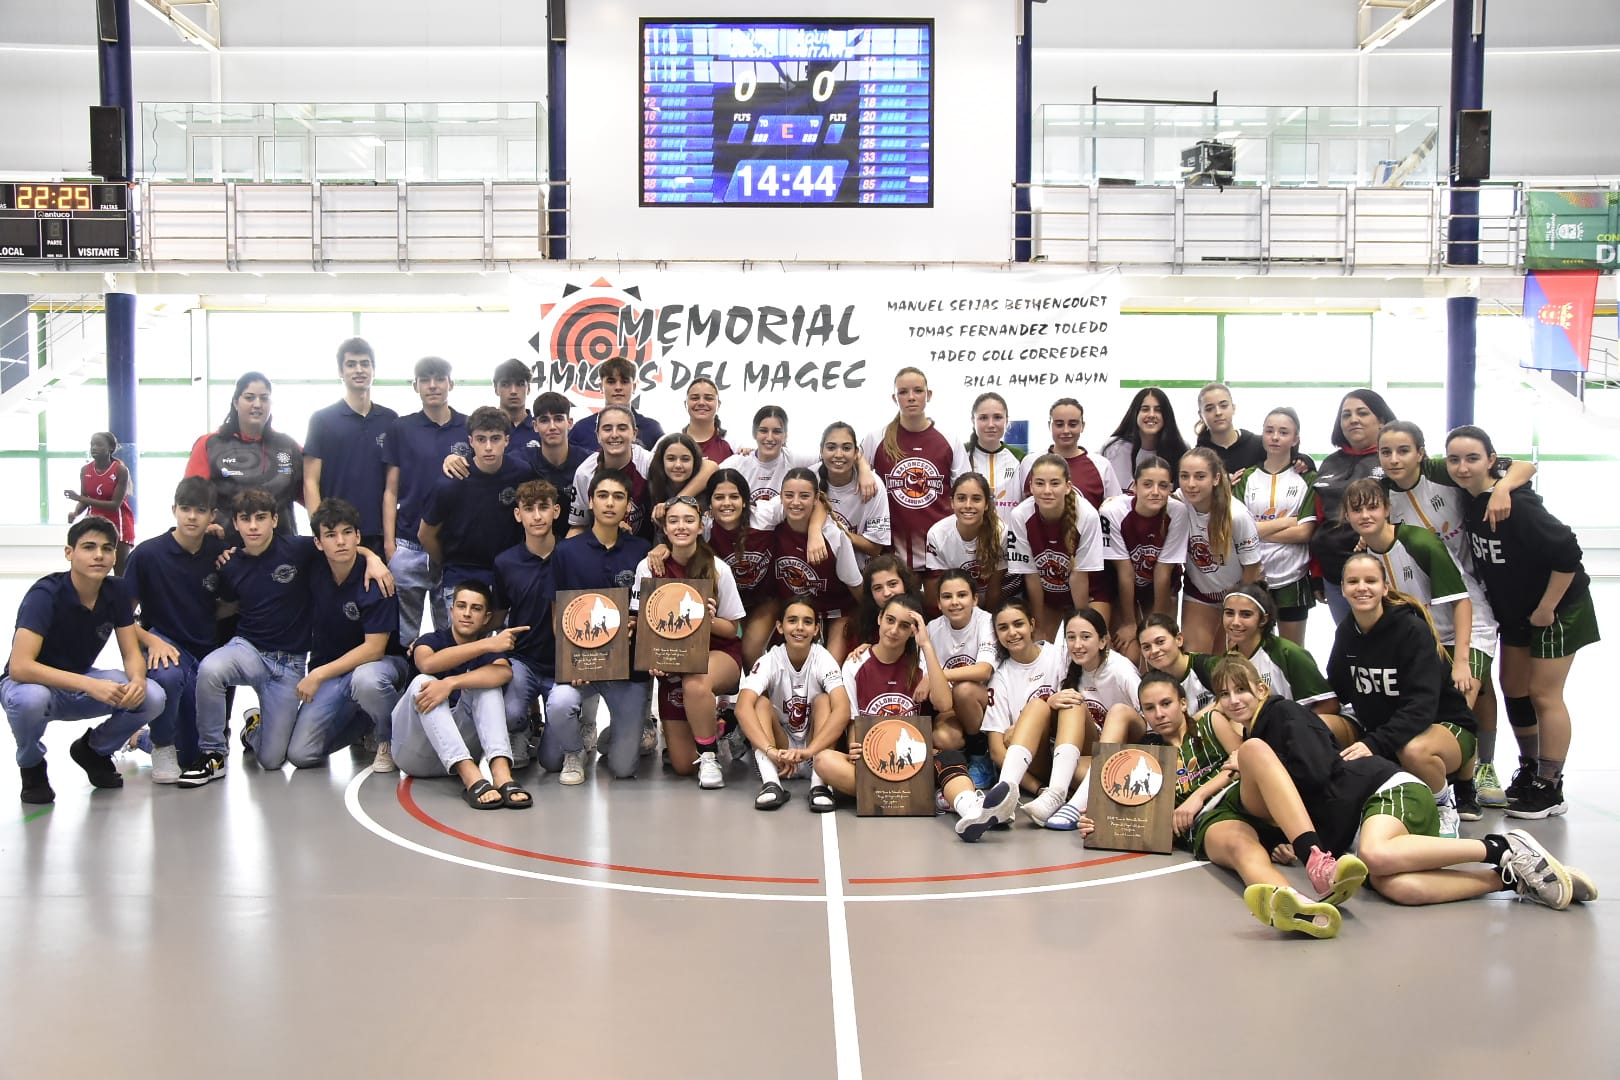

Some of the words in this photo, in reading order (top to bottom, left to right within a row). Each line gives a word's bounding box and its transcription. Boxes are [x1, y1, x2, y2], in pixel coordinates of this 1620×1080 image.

[734, 70, 757, 101] 0
[812, 70, 835, 101] 0
[862, 84, 876, 94] 14
[862, 110, 876, 122] 20
[644, 124, 656, 134] 17
[781, 123, 793, 138] E
[862, 124, 876, 134] 21
[862, 138, 876, 148] 25
[862, 152, 876, 162] 33
[862, 166, 876, 176] 34
[737, 165, 836, 196] 14:44
[17, 186, 89, 208] 22:25
[78, 248, 120, 256] VISITANTE
[887, 300, 945, 312] MANUEL
[950, 299, 999, 311] SEIJAS
[1005, 295, 1108, 310] BETHENCOURT
[618, 304, 860, 347] MEMORIAL
[909, 326, 953, 339] TOMAS
[960, 325, 1047, 338] FERNANDEZ
[1054, 322, 1108, 336] TOLEDO
[930, 351, 976, 362] TADEO
[981, 350, 1014, 361] COLL
[1019, 346, 1108, 361] CORREDERA
[670, 360, 731, 391] DEL
[743, 360, 866, 392] MAGEC
[963, 376, 1002, 387] BILAL
[1009, 373, 1058, 386] AHMED
[1064, 372, 1108, 384] NAYIN
[895, 461, 935, 476] BALONCESTO
[96, 483, 102, 495] 6
[1466, 532, 1506, 564] SFE
